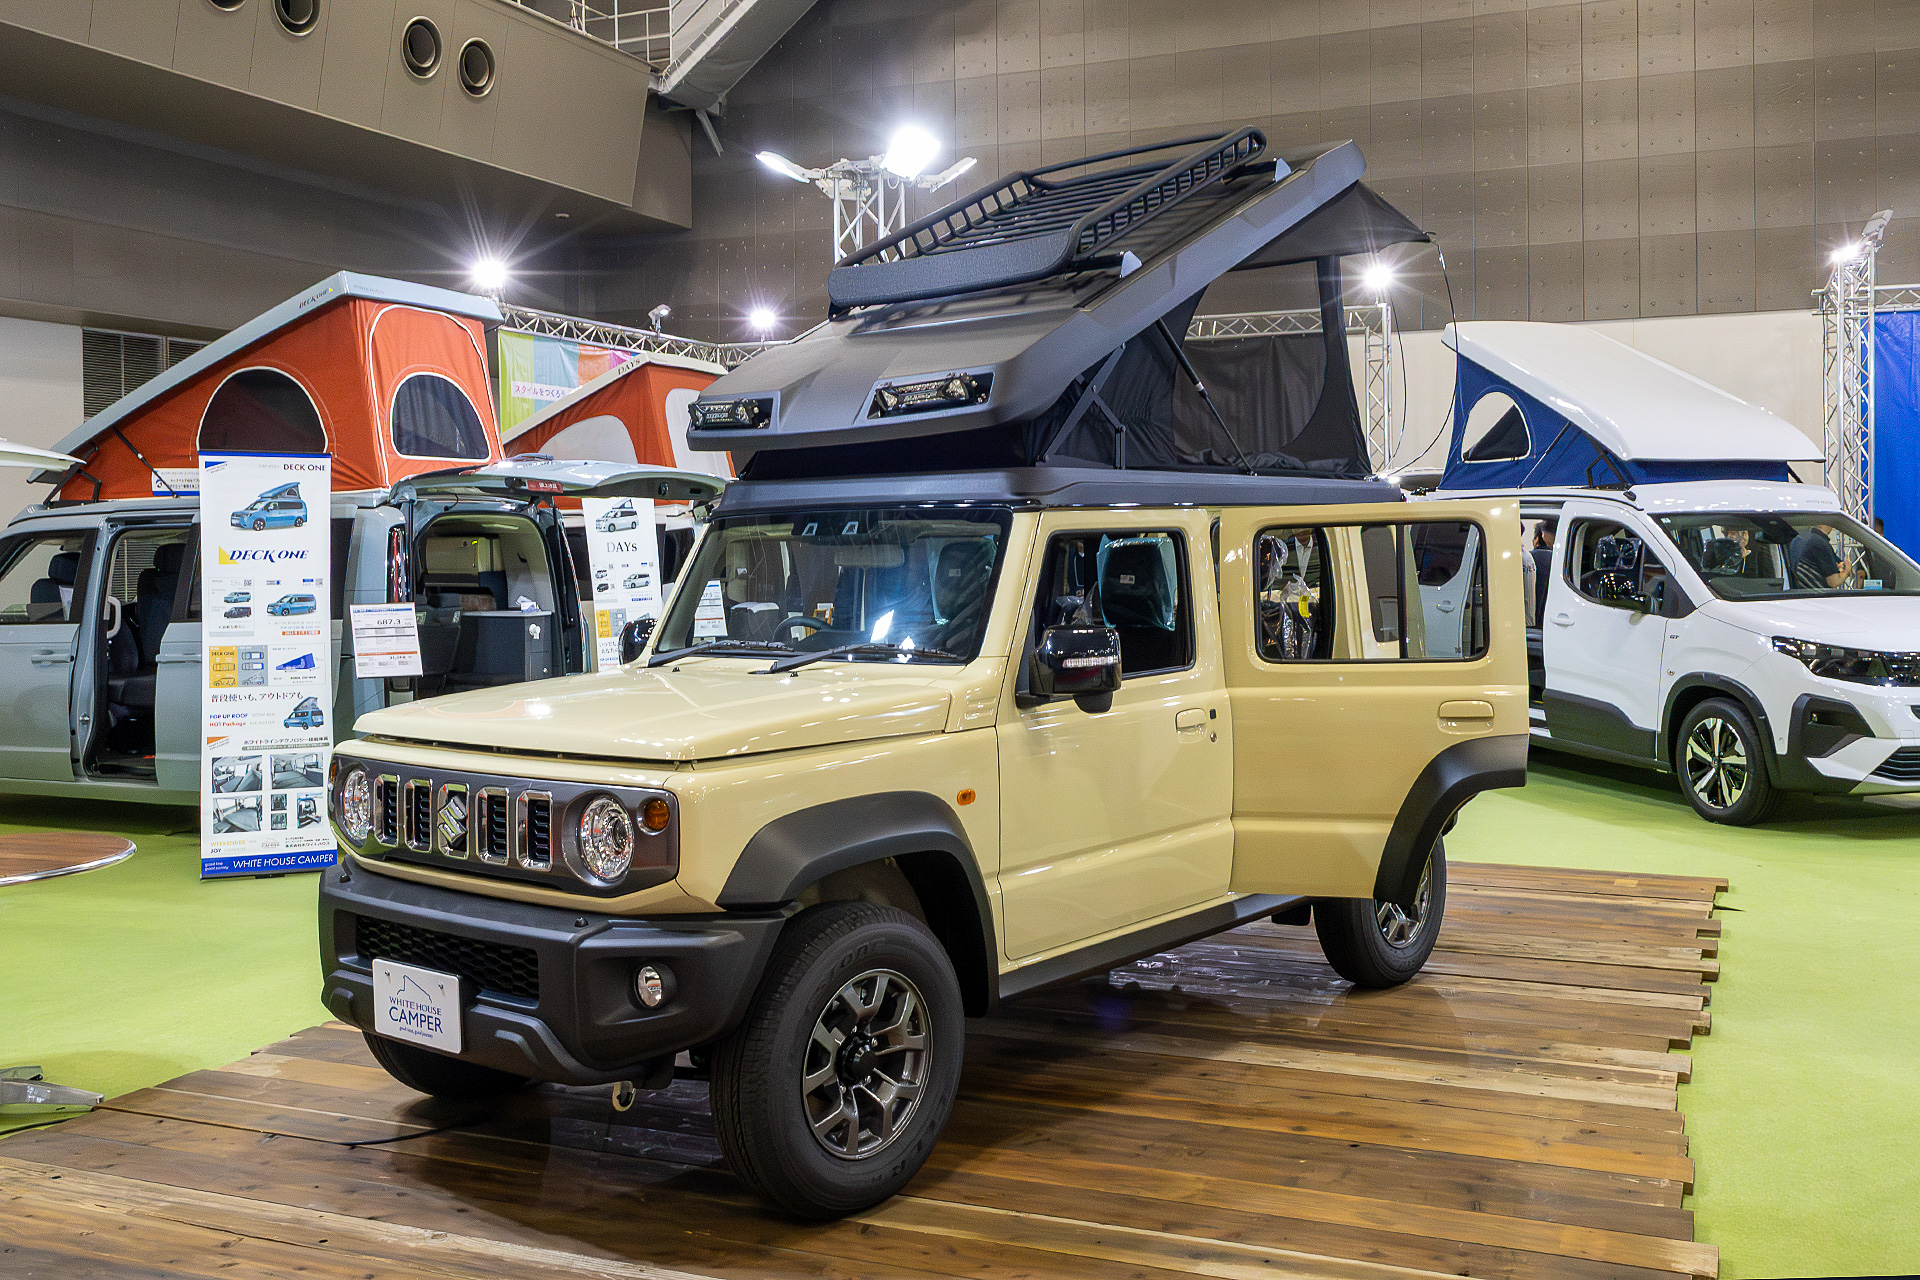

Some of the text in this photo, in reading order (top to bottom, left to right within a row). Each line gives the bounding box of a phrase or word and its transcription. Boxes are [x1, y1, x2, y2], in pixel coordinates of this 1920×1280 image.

[283, 463, 306, 471] DECK
[307, 463, 327, 472] ONE
[229, 549, 310, 563] DECK ONE
[210, 839, 246, 847] WEEKENDER
[232, 858, 262, 869] WHITE
[263, 855, 296, 867] HOUSE
[297, 853, 334, 865] CAMPER
[389, 996, 442, 1016] WHITE HOUSE
[389, 1006, 444, 1034] CAMPER
